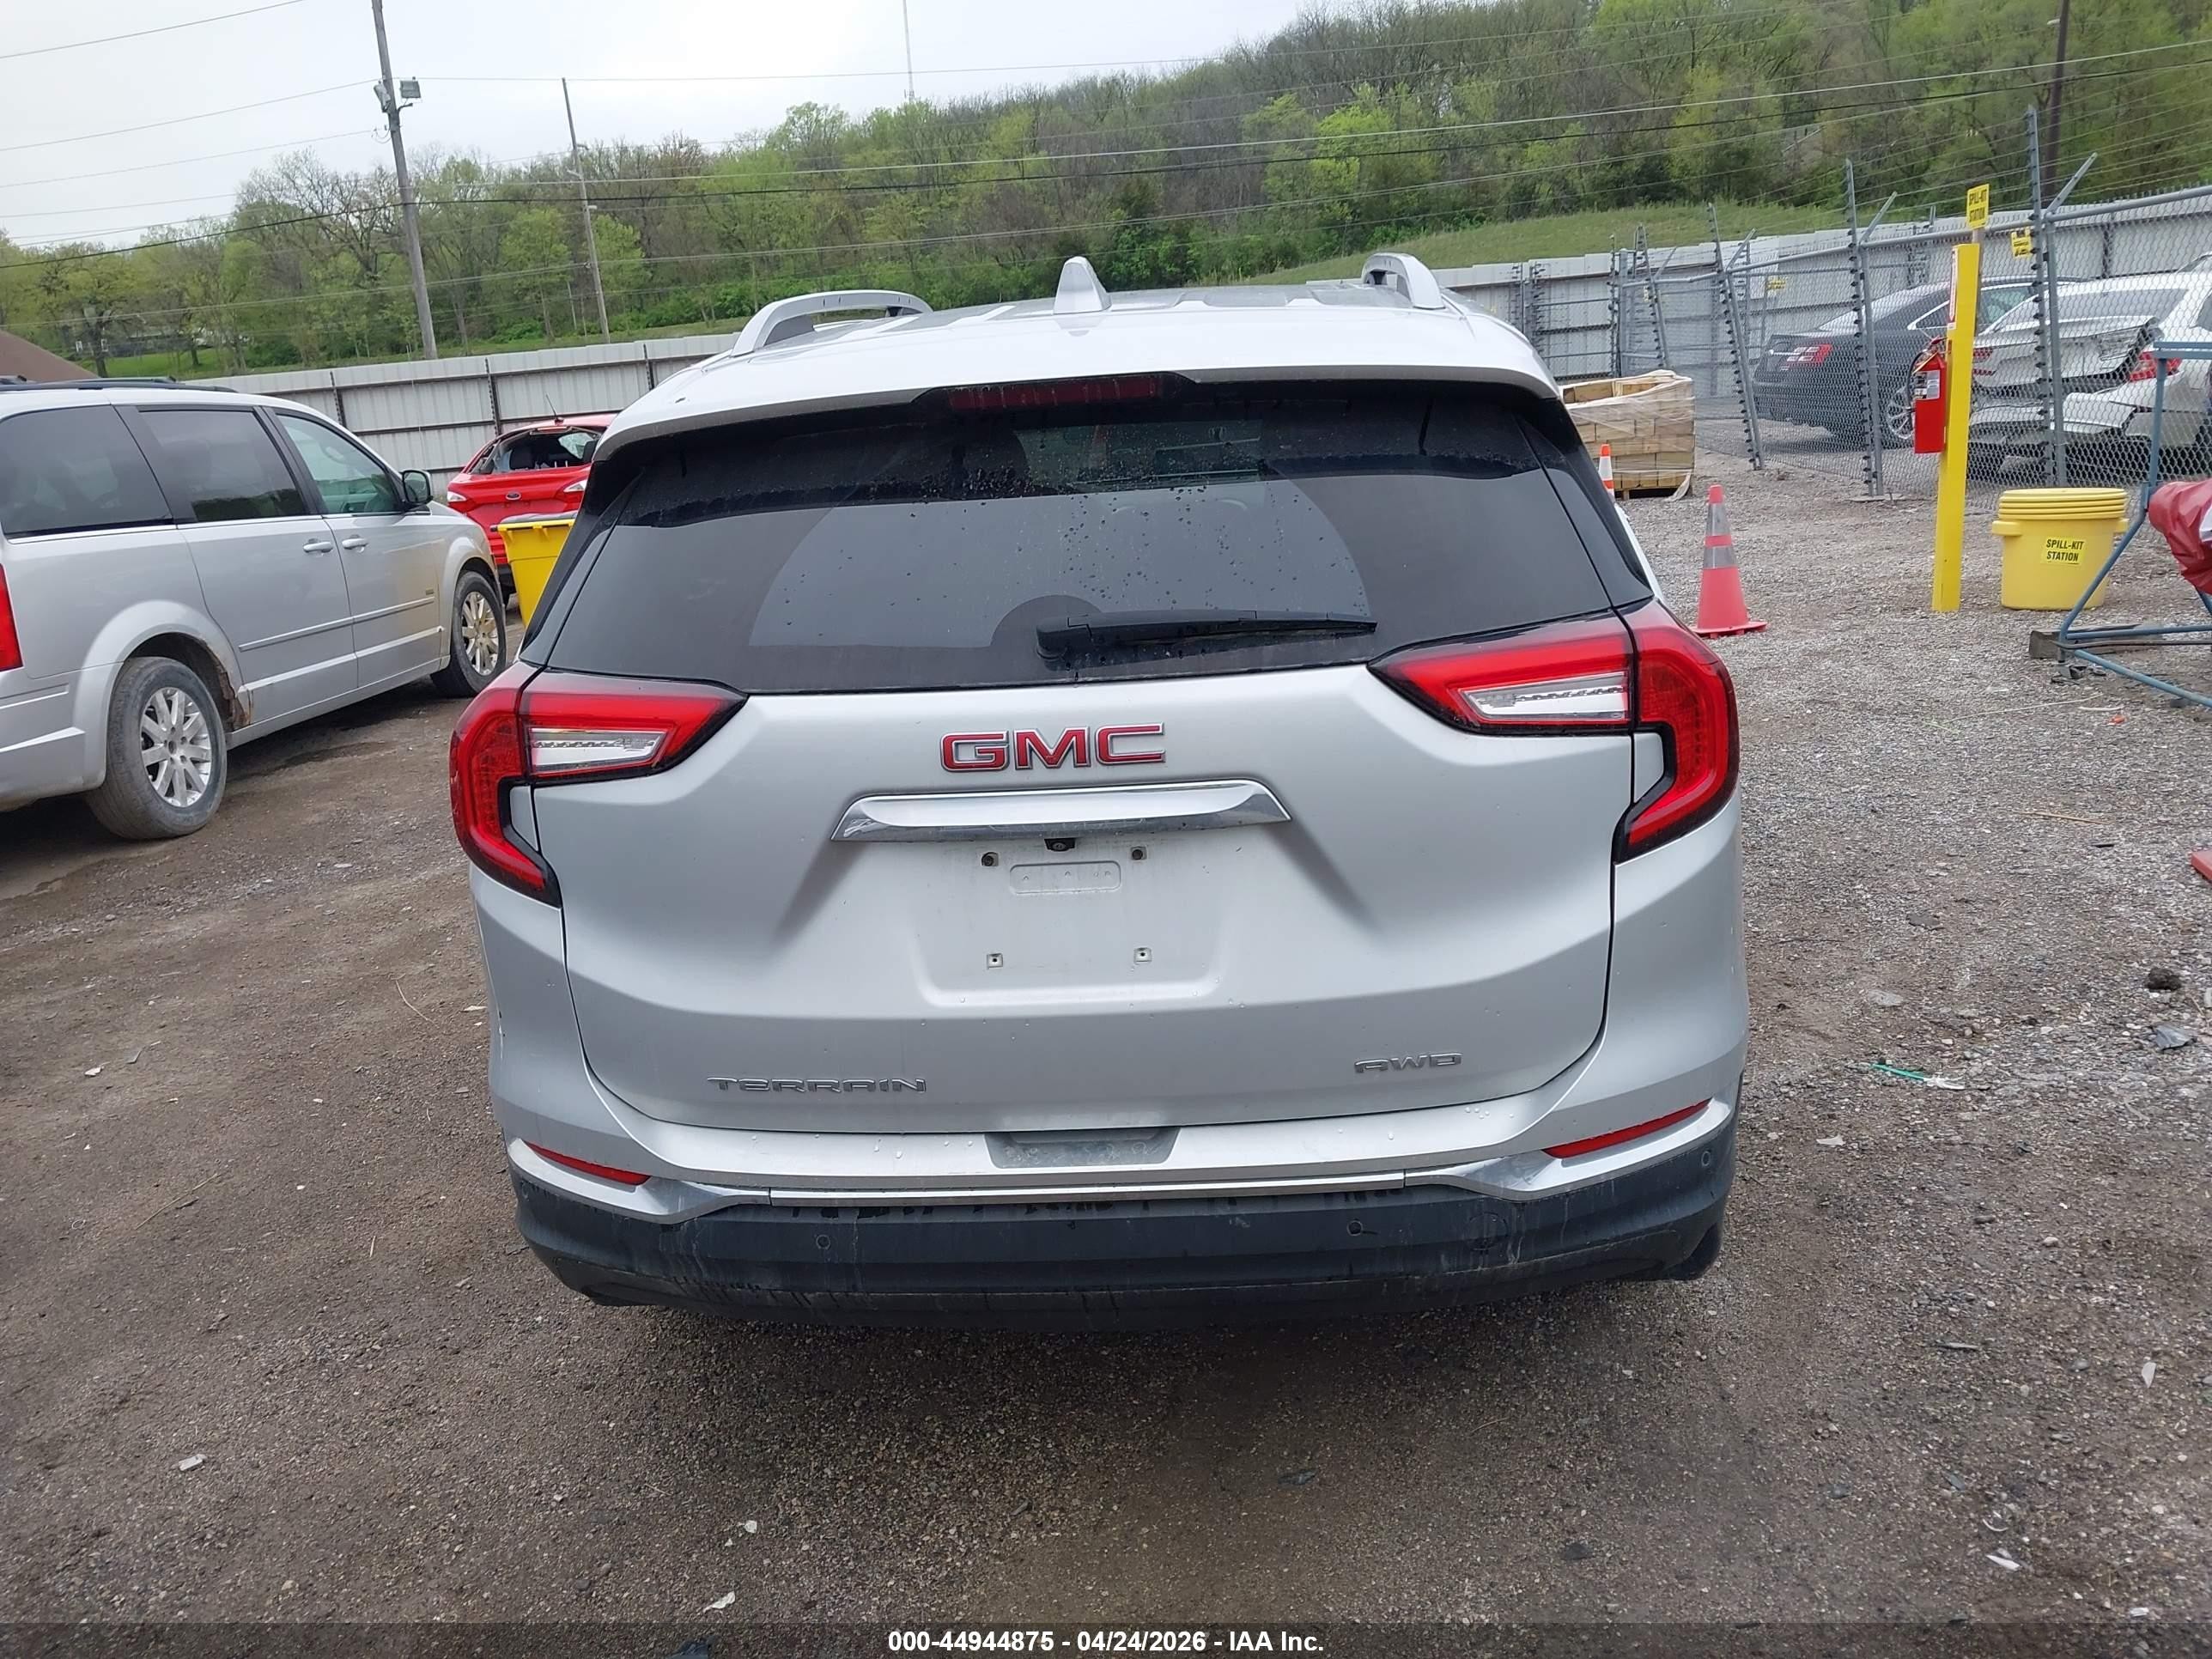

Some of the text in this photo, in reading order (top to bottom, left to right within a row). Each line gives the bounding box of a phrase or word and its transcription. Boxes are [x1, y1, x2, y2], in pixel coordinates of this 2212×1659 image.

[2046, 538, 2085, 550] SPILL-KIT
[2046, 551, 2079, 562] STATION
[941, 723, 1166, 772] GMC
[1354, 1053, 1463, 1073] AWD
[707, 1077, 927, 1092] TERRAIN
